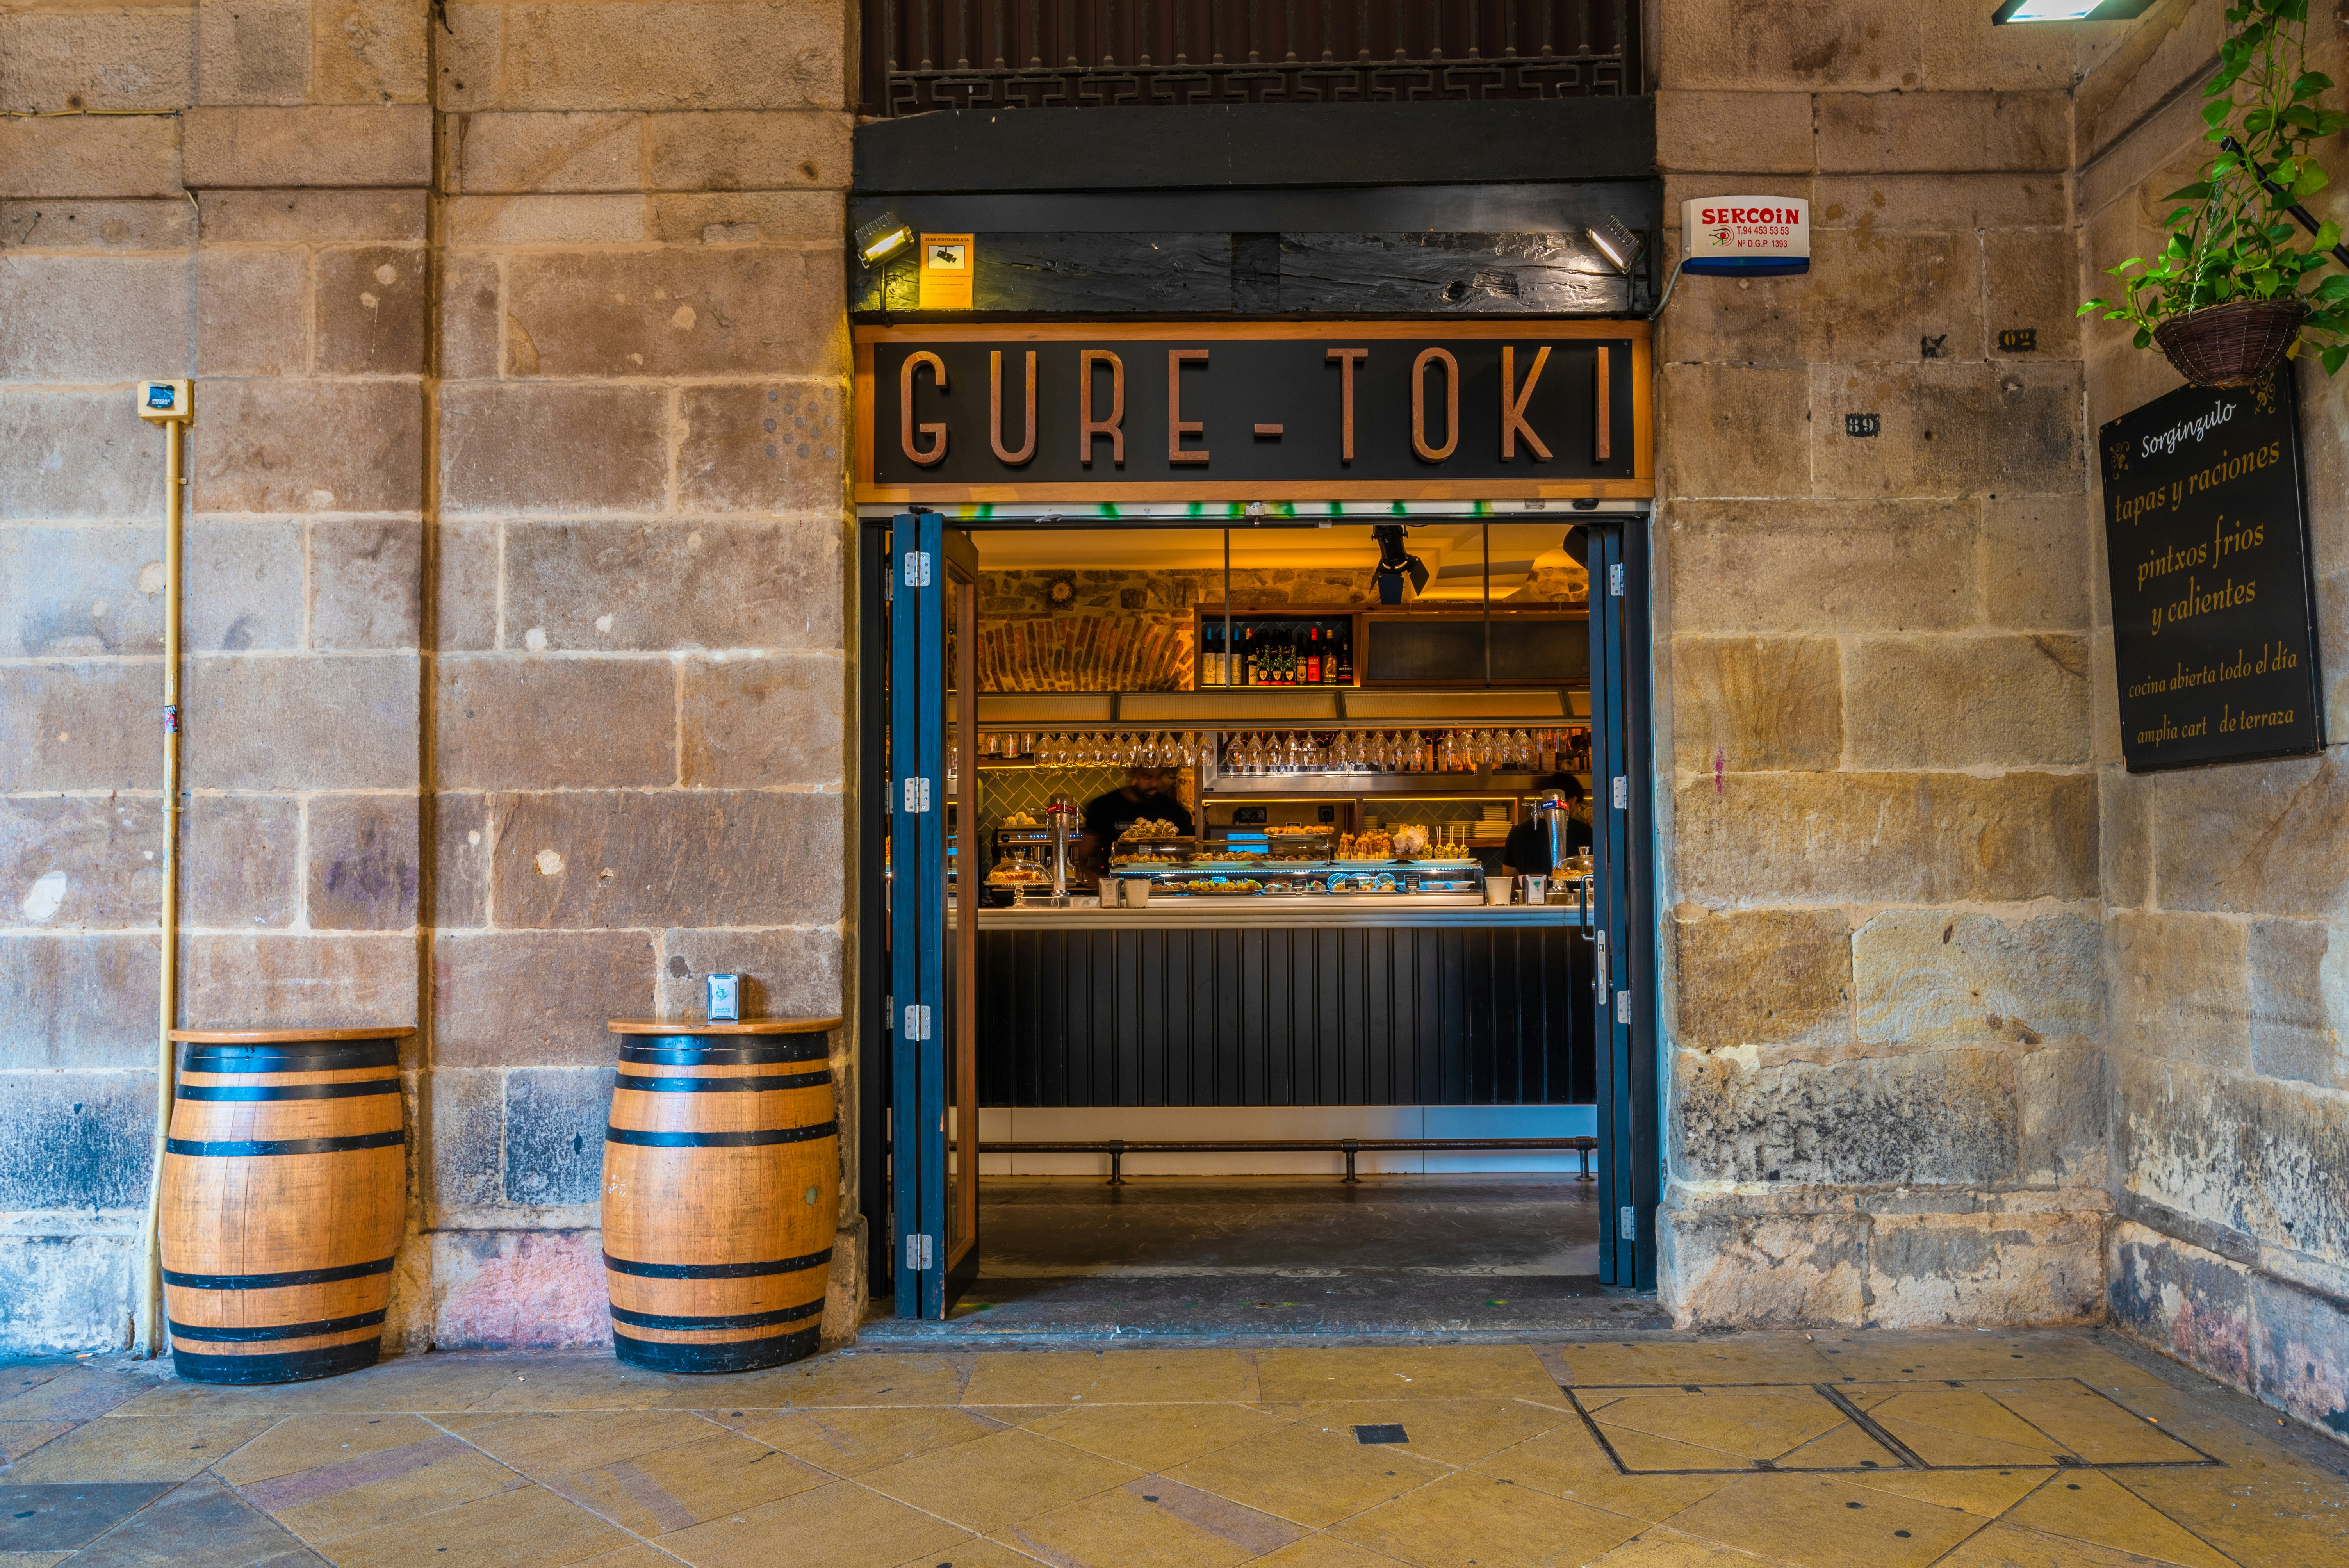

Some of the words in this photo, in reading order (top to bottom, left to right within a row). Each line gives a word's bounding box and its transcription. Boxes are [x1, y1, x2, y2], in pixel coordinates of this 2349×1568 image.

[1736, 226, 1752, 235] T.94
[1754, 226, 1767, 235] 453
[1770, 226, 1779, 235] 53
[1780, 226, 1789, 235] 53
[1748, 239, 1769, 248] D.G.P.
[1848, 418, 1874, 432] 89
[2116, 485, 2165, 526] tapas
[2171, 480, 2182, 511] y
[2189, 439, 2279, 494] raciones
[2138, 542, 2206, 592] pintxos
[2213, 515, 2263, 569] frios
[2151, 608, 2162, 636] y
[2168, 576, 2255, 622] calientes
[2129, 675, 2166, 698] cocina
[2170, 662, 2216, 690] abierta
[2220, 649, 2251, 681] todo
[2256, 644, 2268, 674] el
[2272, 641, 2297, 671] día
[2137, 714, 2178, 748] amplia
[2181, 716, 2207, 738] cart
[2219, 704, 2236, 733] de
[2240, 709, 2294, 730] terraza
